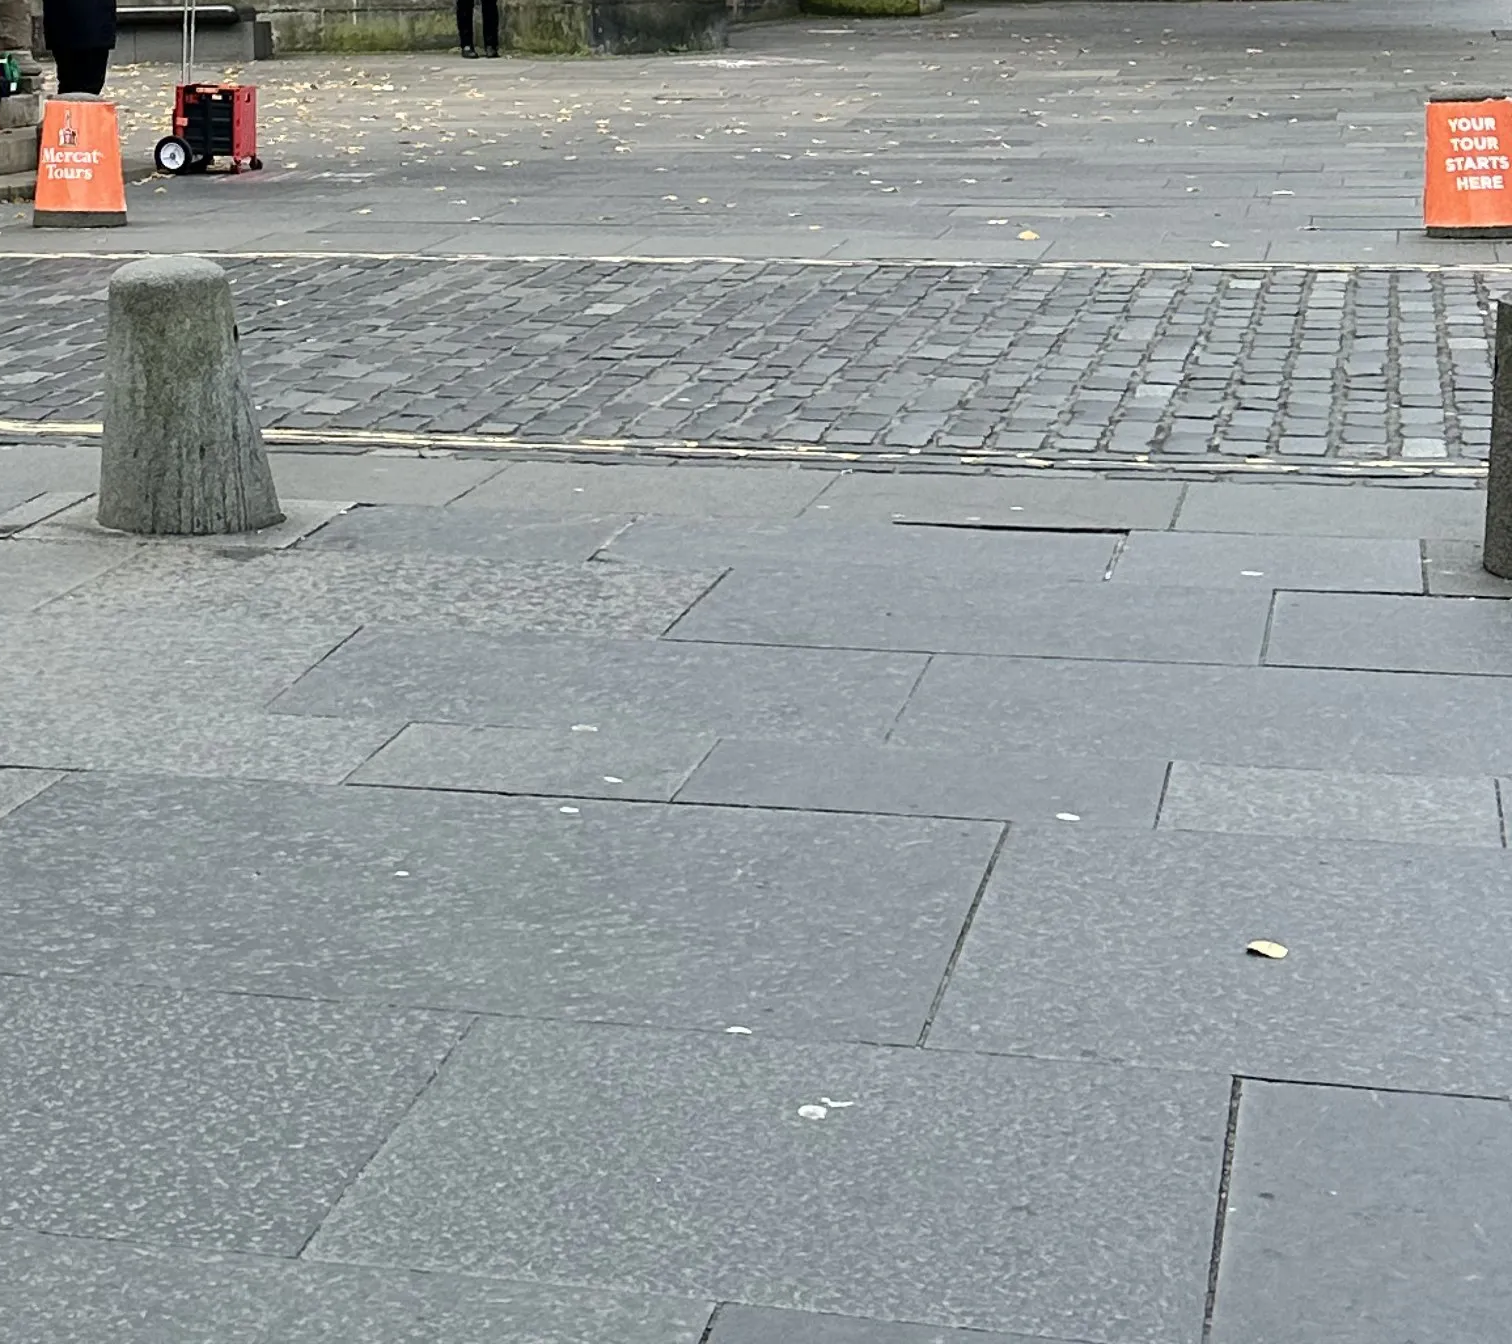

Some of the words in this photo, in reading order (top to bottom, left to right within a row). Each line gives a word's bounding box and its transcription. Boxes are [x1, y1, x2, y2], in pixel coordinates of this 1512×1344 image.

[1448, 117, 1496, 132] YOUR
[1449, 136, 1499, 152] TOUR
[42, 148, 99, 164] Mercat
[1445, 155, 1509, 172] STARTS
[46, 163, 93, 180] Tours
[1456, 175, 1504, 190] HERE
